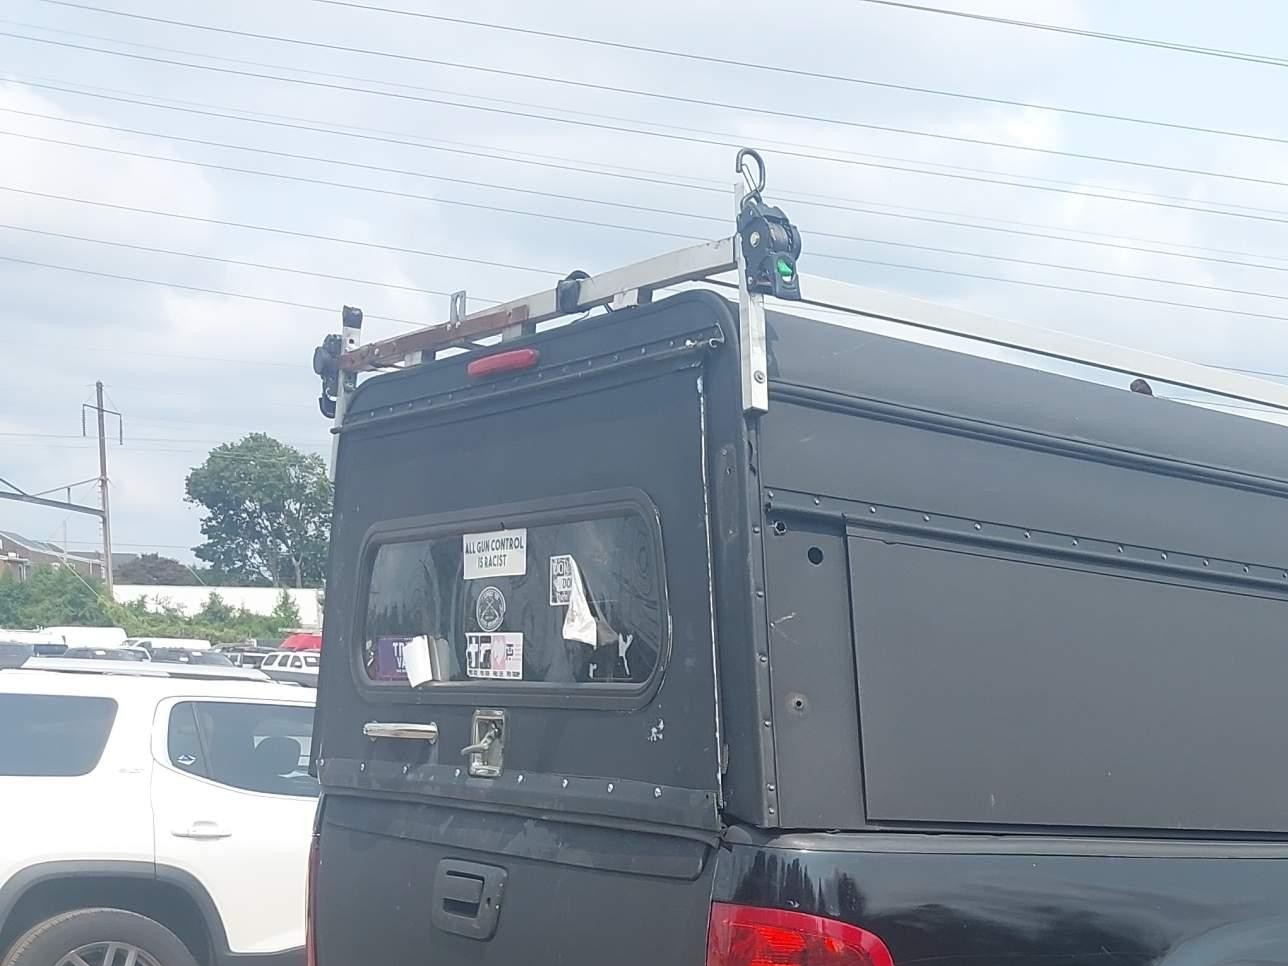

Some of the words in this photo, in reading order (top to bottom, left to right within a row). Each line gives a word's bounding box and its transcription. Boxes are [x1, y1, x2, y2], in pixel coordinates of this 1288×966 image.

[465, 543, 476, 554] ALL
[477, 539, 490, 553] GUN
[491, 536, 524, 552] CONTROL
[477, 557, 483, 568] IS
[484, 554, 507, 568] RACIST
